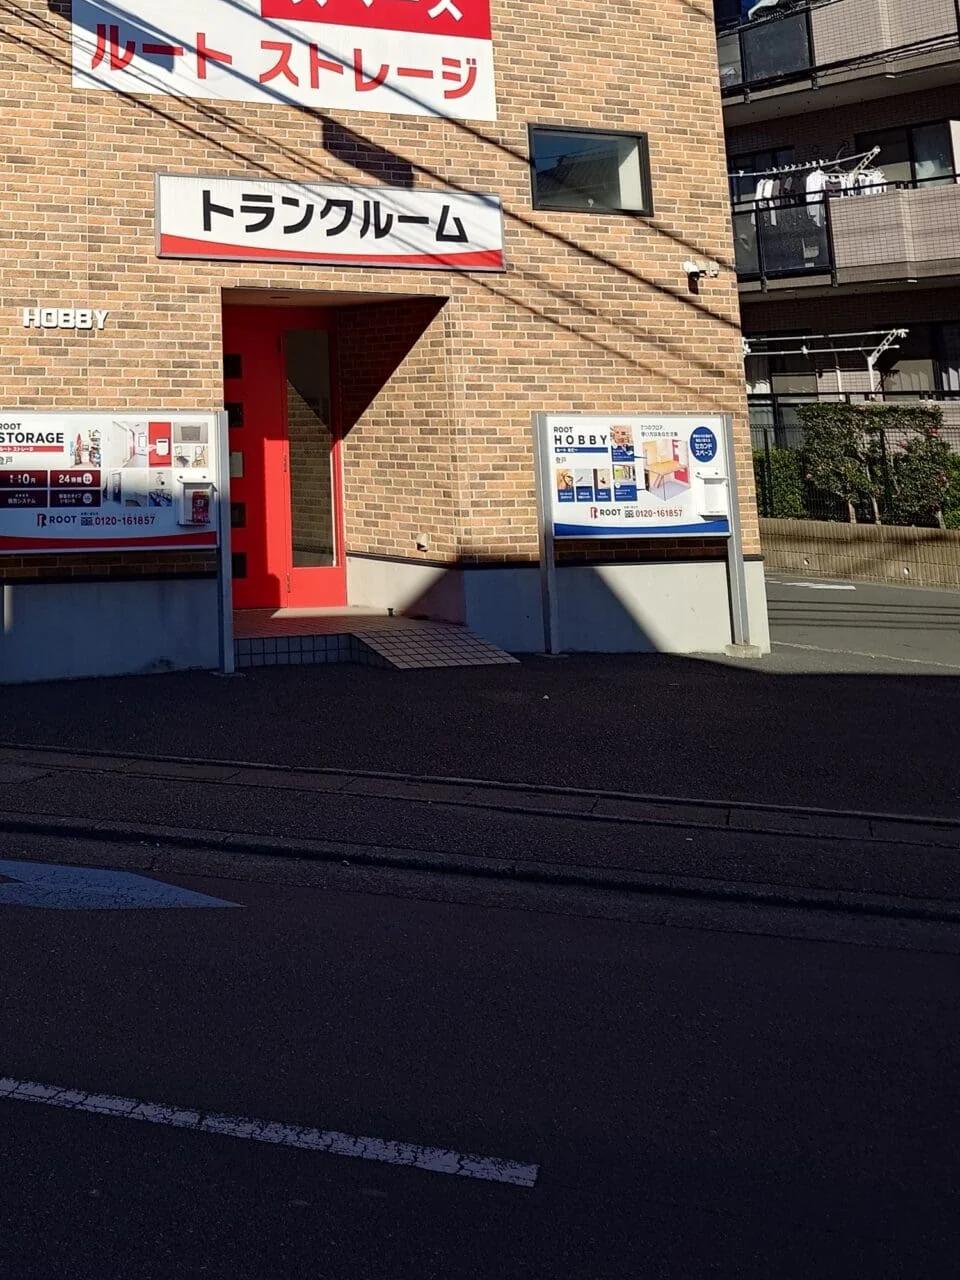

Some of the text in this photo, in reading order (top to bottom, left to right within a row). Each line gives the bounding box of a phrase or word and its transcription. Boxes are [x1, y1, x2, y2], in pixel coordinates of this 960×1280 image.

[90, 23, 478, 99] ルート ストレージ
[202, 190, 469, 243] トランクルーム
[23, 308, 108, 329] HOBBY
[554, 435, 607, 445] HOBBY
[600, 508, 621, 516] ROOT
[635, 509, 683, 517] 0120-161857
[49, 515, 77, 524] ROOT
[94, 516, 156, 526] 0120-161857
